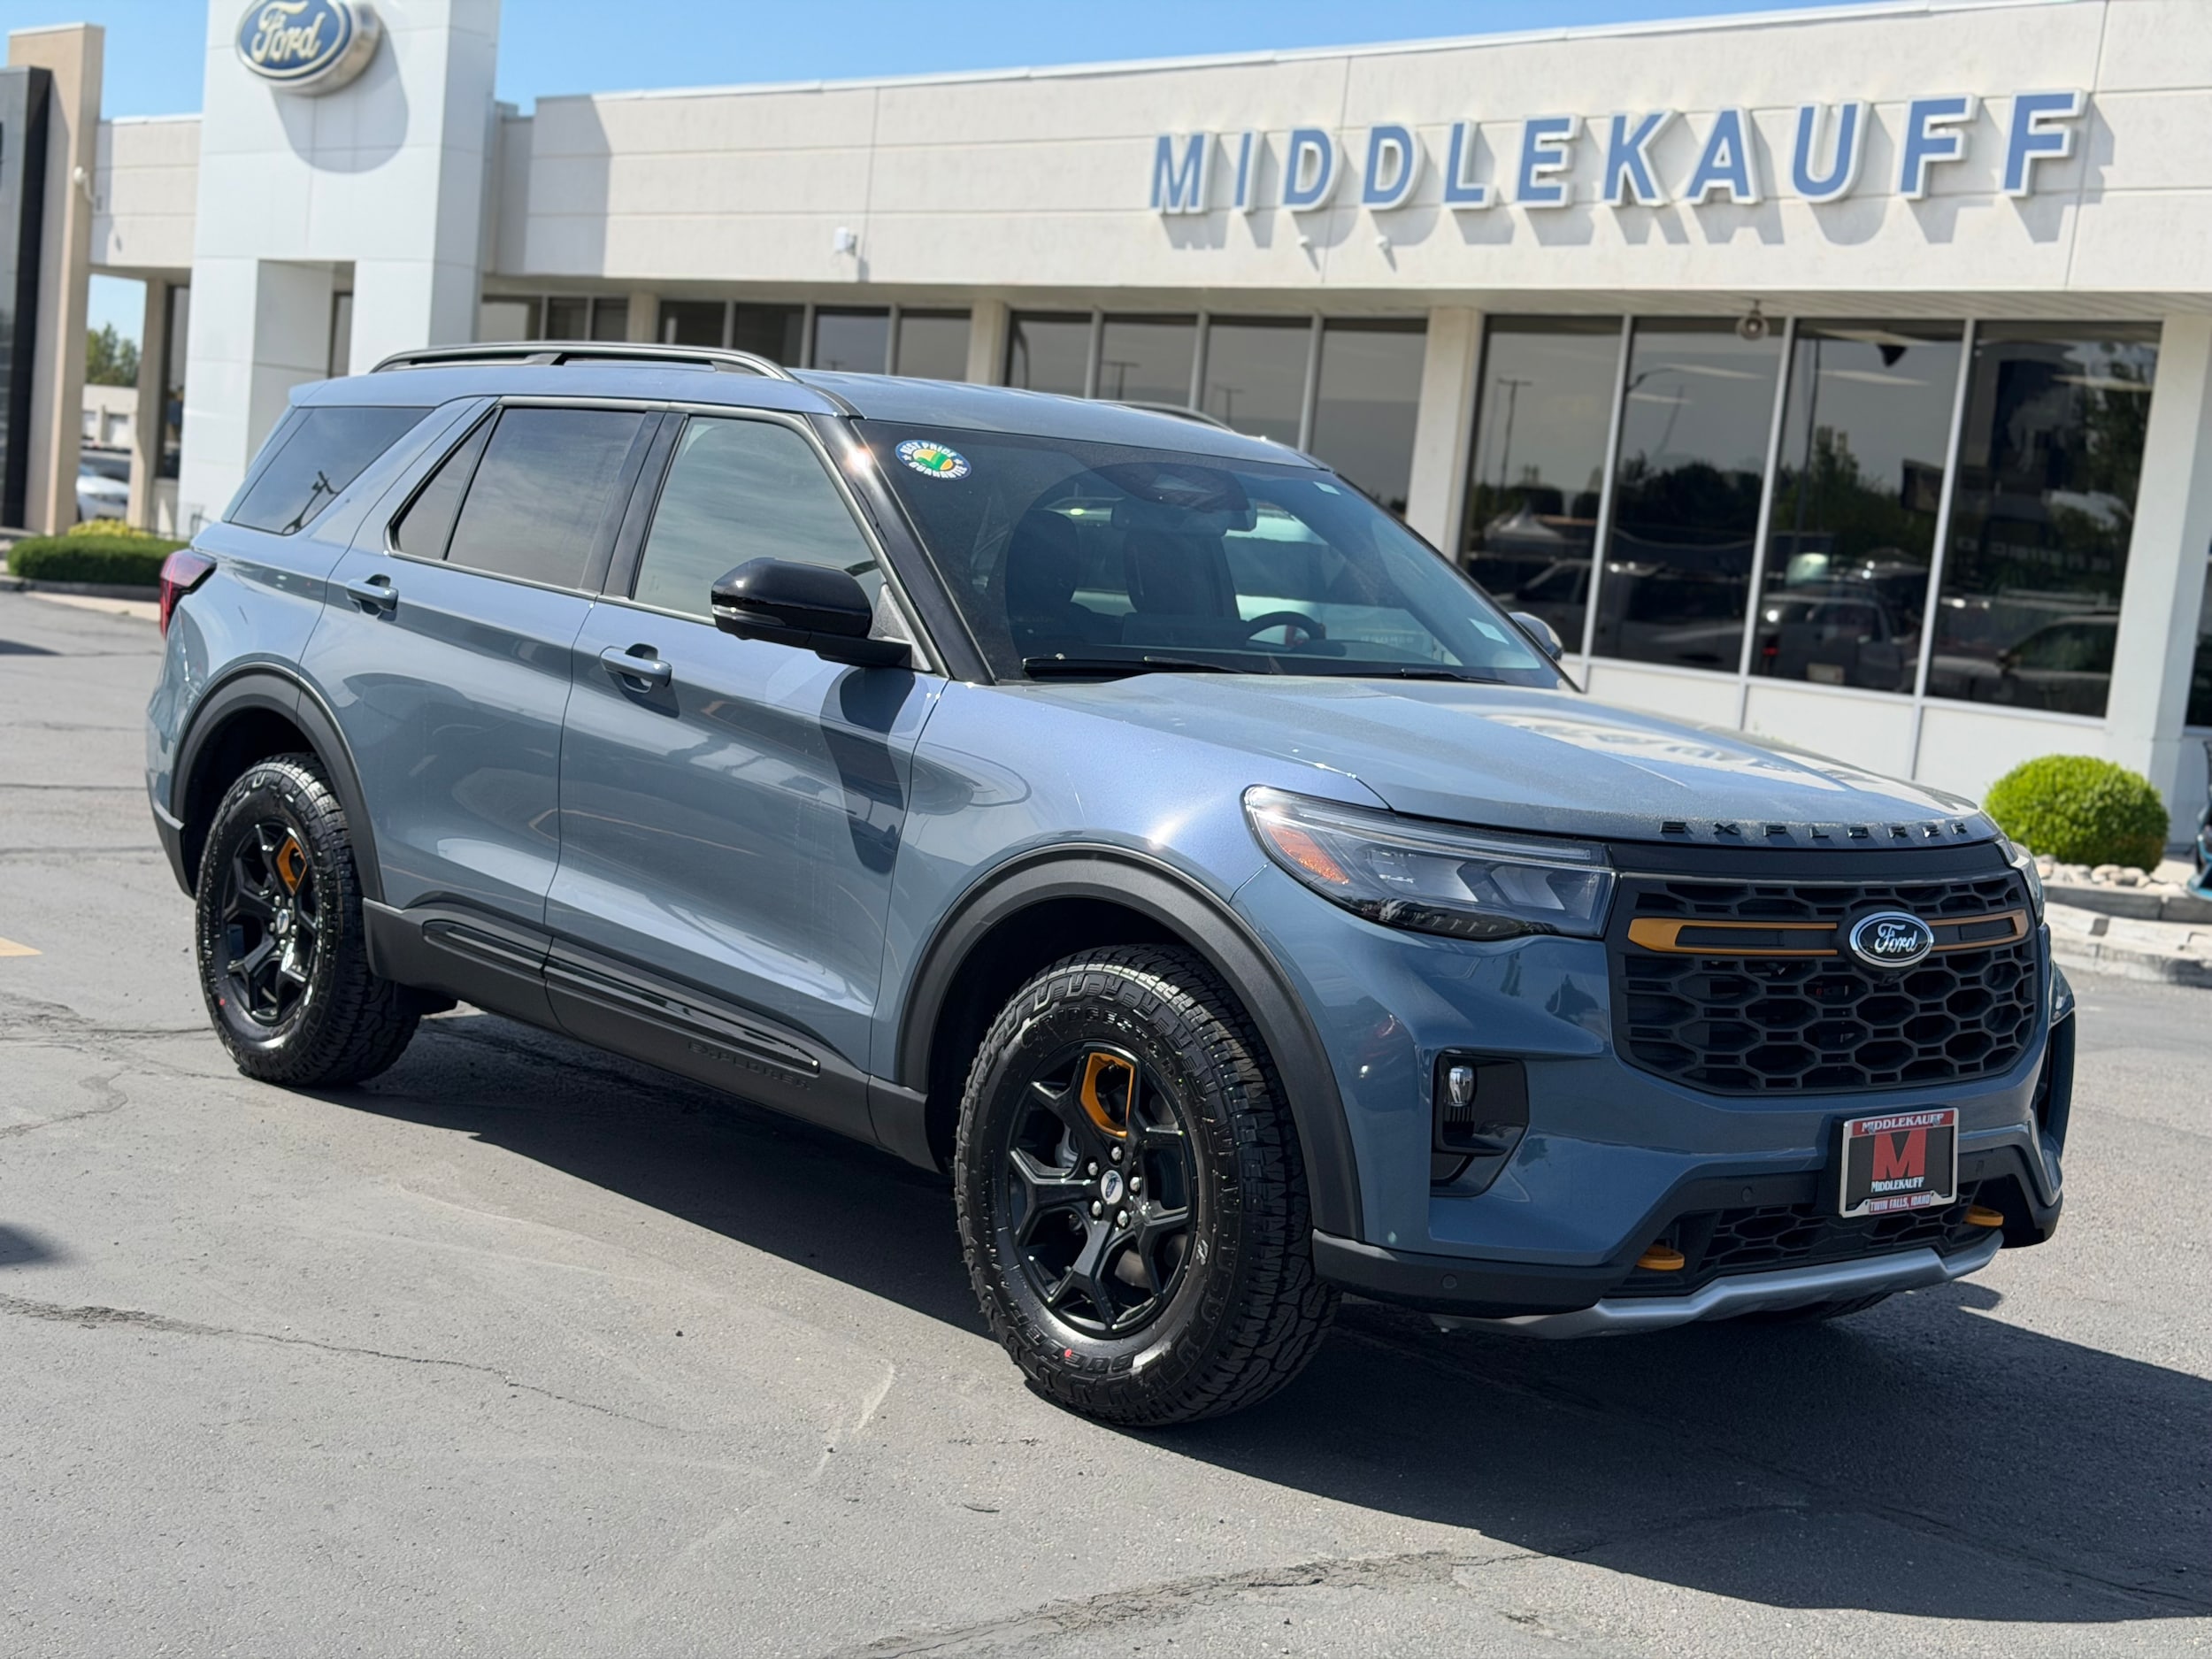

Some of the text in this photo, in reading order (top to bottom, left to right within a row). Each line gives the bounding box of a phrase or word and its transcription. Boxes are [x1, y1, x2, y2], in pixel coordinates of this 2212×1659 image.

[251, 0, 325, 64] Ford
[1150, 89, 2086, 214] MIDDLEKAUFF
[900, 442, 956, 457] BEST PRICE
[1660, 820, 1968, 838] EXPLORER
[1874, 923, 1917, 953] Ford
[1872, 1128, 1926, 1179] M
[1871, 1178, 1924, 1193] MIDDLEKAUFF
[1870, 1194, 1931, 1211] TWIN FALLS, IDAHO
